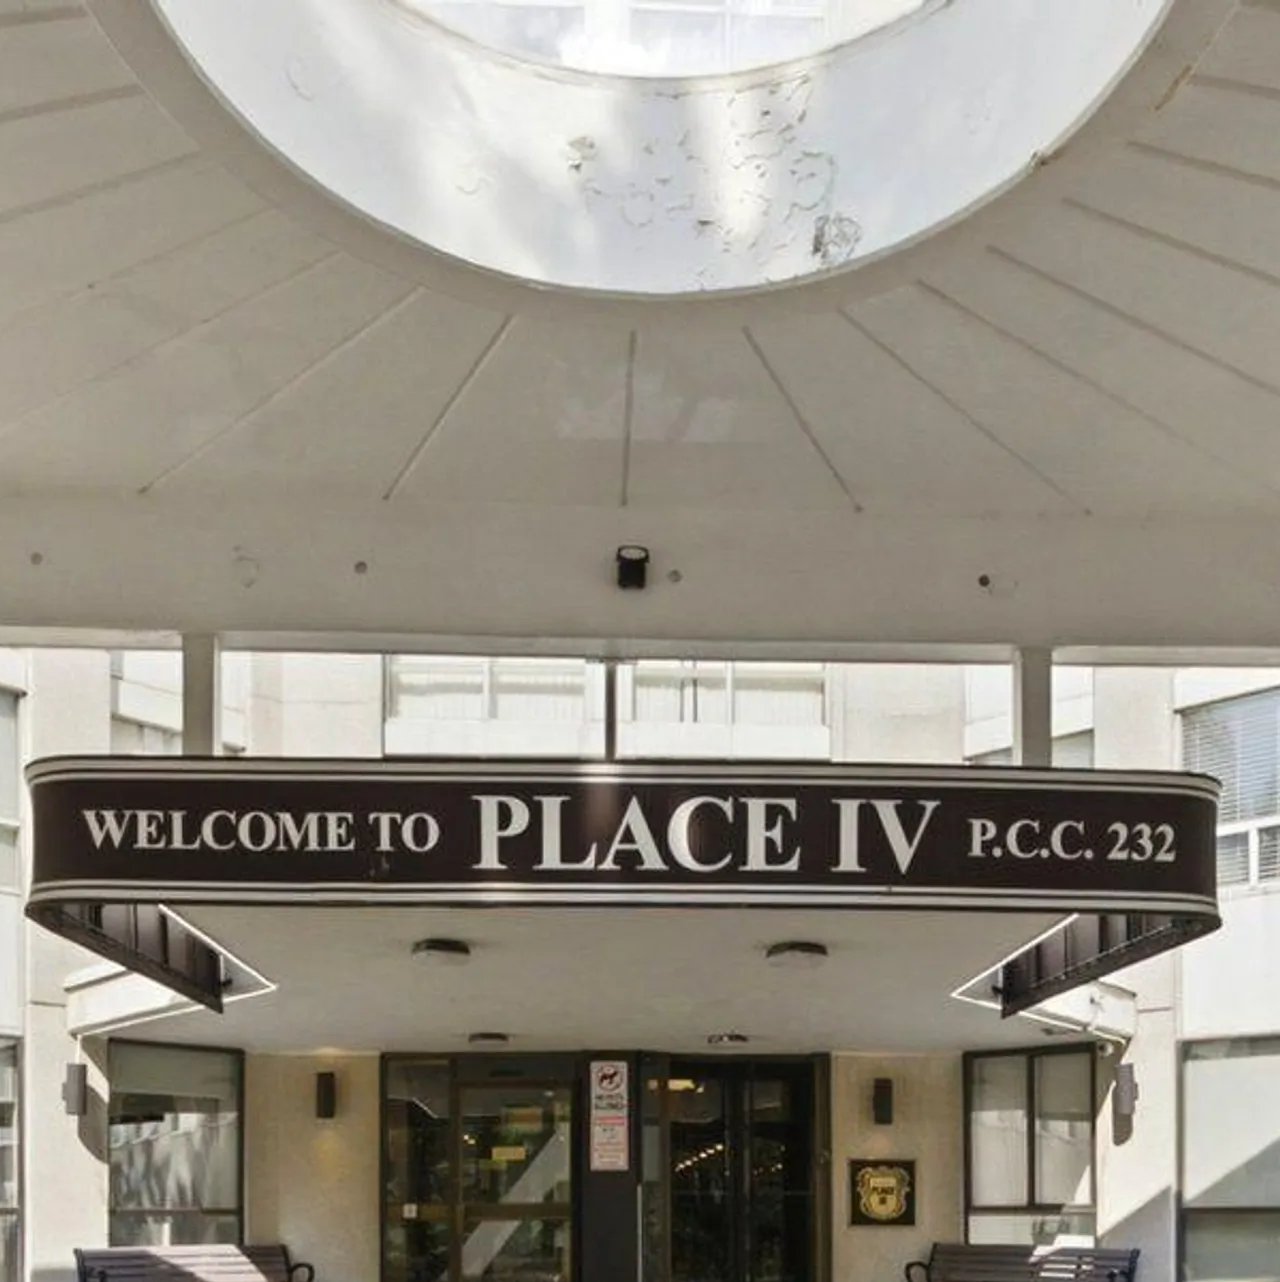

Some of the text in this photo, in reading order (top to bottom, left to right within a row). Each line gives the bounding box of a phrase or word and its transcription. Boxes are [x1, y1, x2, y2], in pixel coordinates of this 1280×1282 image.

[82, 795, 1176, 875] WELCOME TO PLACE IV P.C.C. 232
